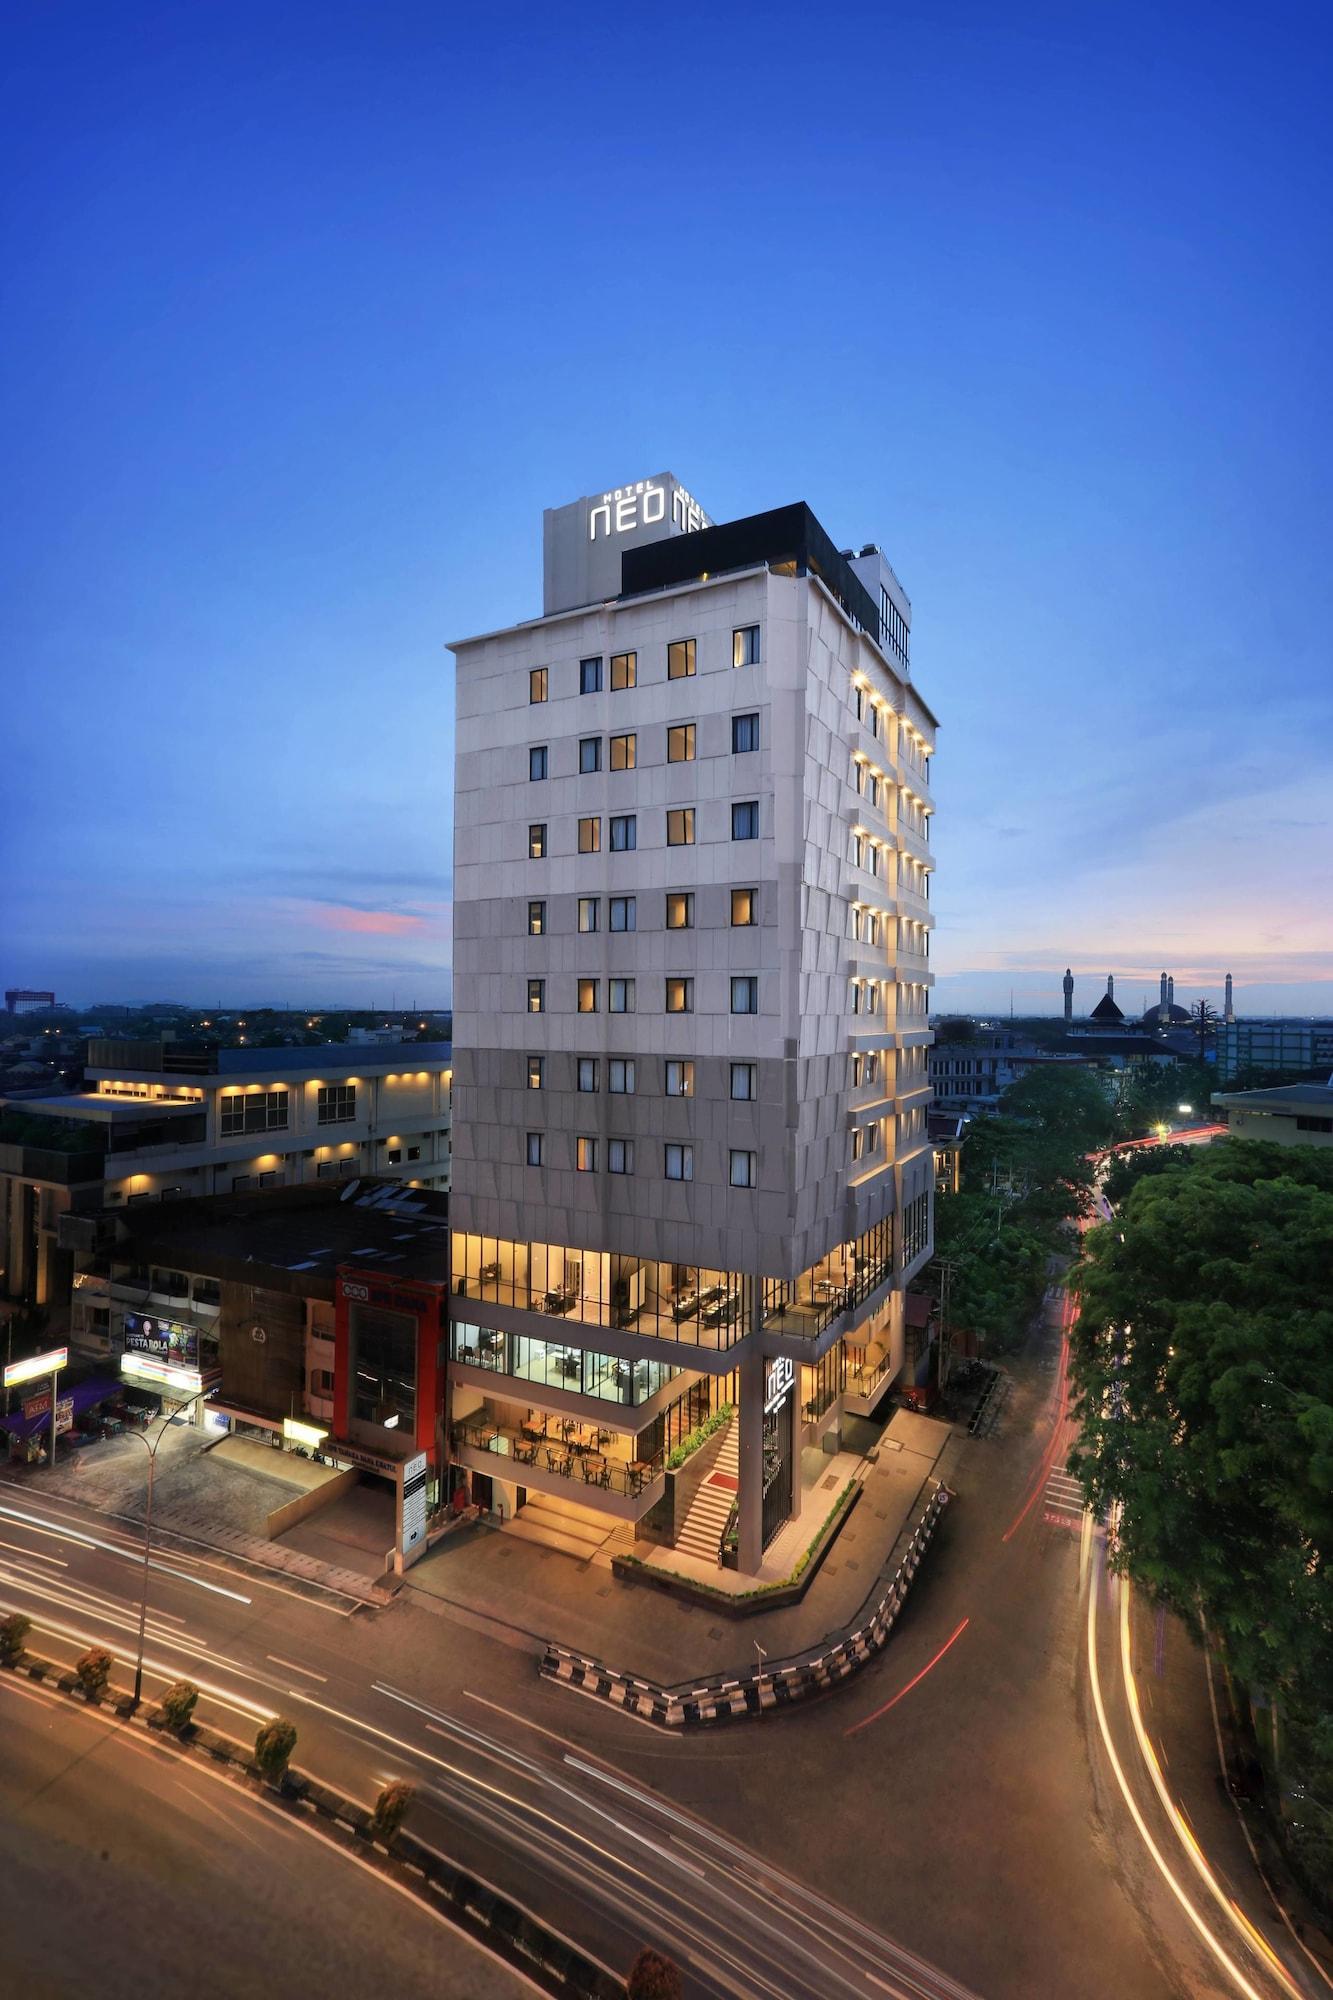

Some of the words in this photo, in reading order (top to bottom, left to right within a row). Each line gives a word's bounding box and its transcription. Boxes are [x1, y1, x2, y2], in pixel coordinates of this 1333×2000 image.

[590, 487, 665, 540] NEO
[603, 480, 654, 504] HOTEL
[673, 489, 710, 533] NE
